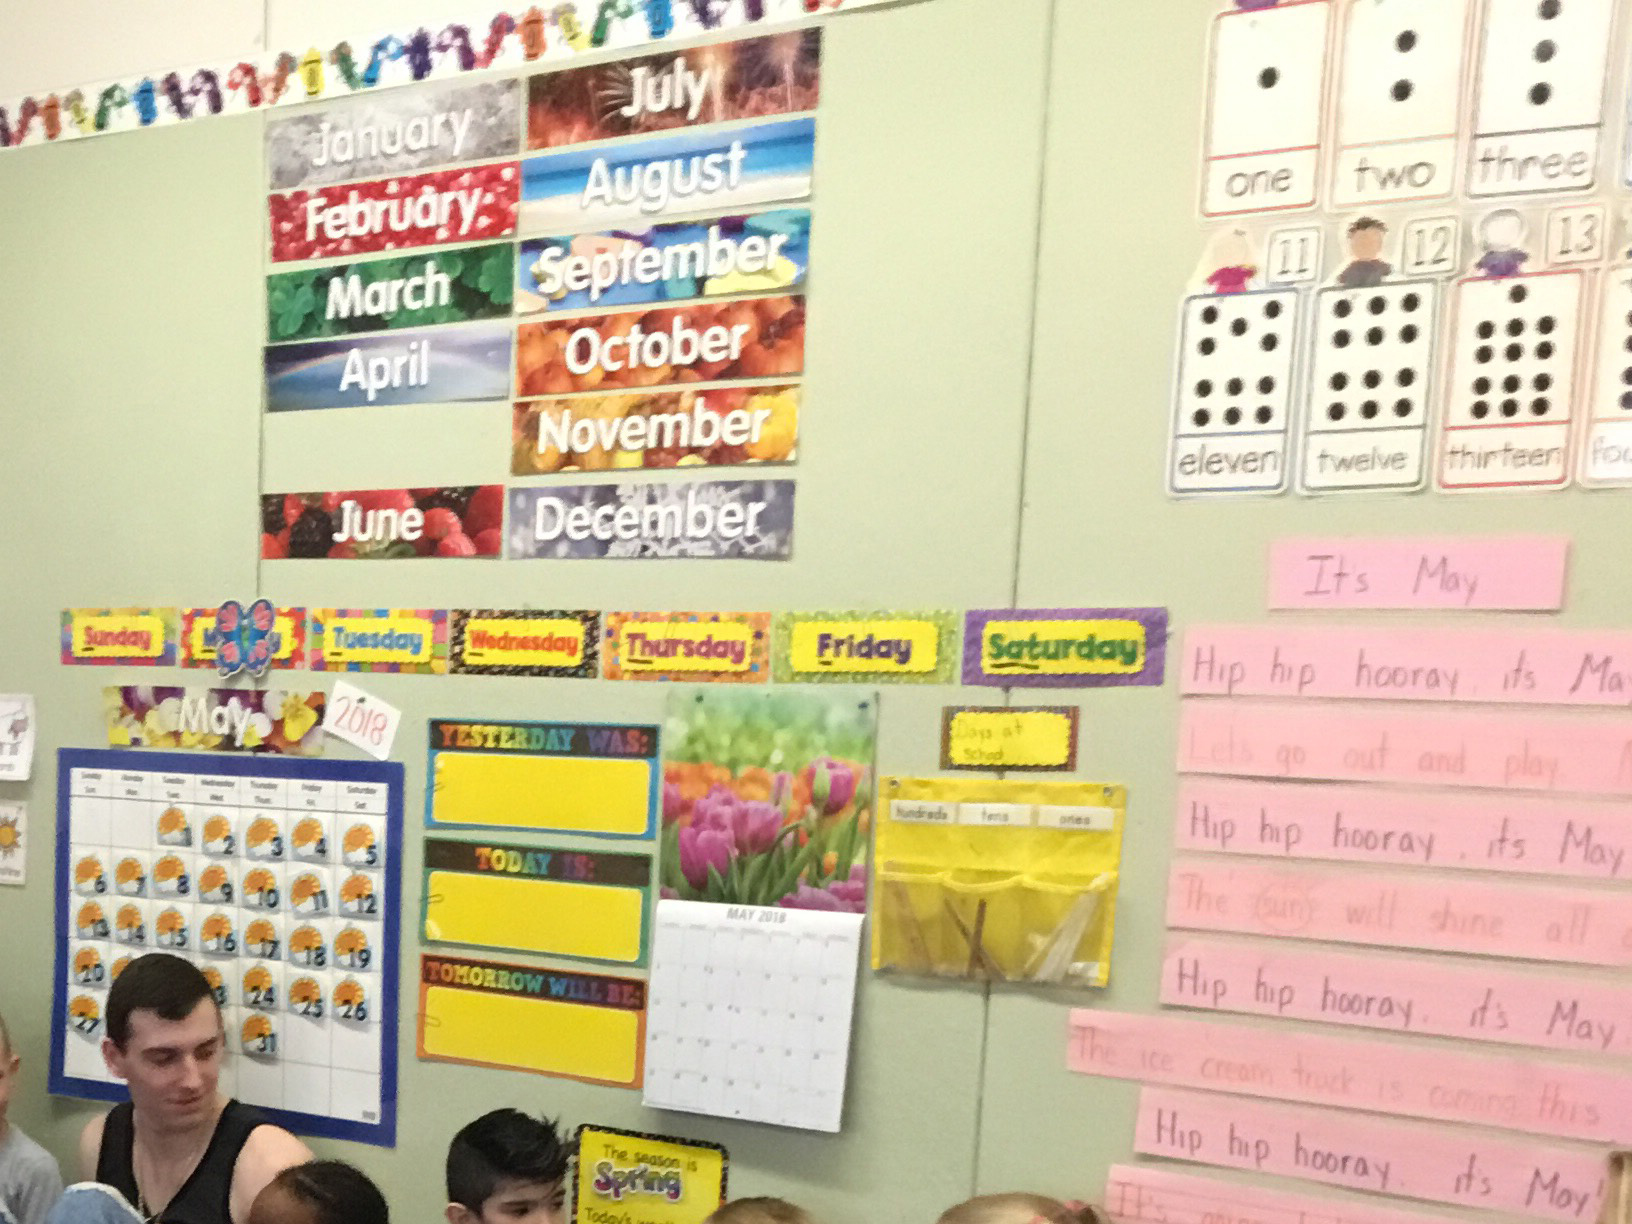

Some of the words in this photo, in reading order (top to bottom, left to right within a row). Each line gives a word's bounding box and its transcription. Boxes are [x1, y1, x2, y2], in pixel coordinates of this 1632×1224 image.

[621, 56, 711, 119] July
[312, 107, 473, 168] January
[581, 141, 747, 212] August
[1225, 166, 1293, 199] one
[1353, 156, 1436, 189] two
[1477, 144, 1590, 183] three
[304, 187, 482, 242] February
[1557, 213, 1597, 257] 13
[538, 226, 790, 300] September
[1276, 236, 1308, 277] 11
[1413, 227, 1450, 267] 12
[324, 262, 451, 321] March
[565, 315, 750, 376] October
[339, 341, 430, 402] April
[537, 397, 772, 456] November
[1178, 443, 1280, 478] eleven
[1316, 448, 1409, 474] twelve
[1444, 442, 1563, 472] thirteen
[331, 498, 426, 544] June
[533, 490, 768, 542] December
[1411, 554, 1479, 607] May
[83, 623, 152, 651] Sunday
[333, 625, 424, 656] Tuesday
[469, 628, 579, 657] Wednesday
[625, 631, 747, 667] Thursday
[817, 632, 913, 664] Friday
[989, 631, 1138, 665] Saturday
[1192, 645, 1246, 697] Hip
[1269, 646, 1316, 697] hip
[179, 695, 253, 748] May
[334, 694, 389, 746] 2018
[439, 723, 576, 751] YESTERDAY
[586, 729, 649, 755] WAS:
[1276, 743, 1307, 775] go
[1343, 731, 1390, 769] out
[1418, 741, 1467, 776] and
[1190, 801, 1236, 842] Hip
[1259, 806, 1301, 849] hip
[1559, 820, 1626, 878] May
[475, 847, 553, 875] TODAY
[562, 854, 596, 878] IS:
[727, 907, 757, 921] MAY
[759, 909, 788, 924] 2018
[426, 960, 544, 994] TOMORROW
[549, 975, 603, 1001] WILL
[606, 983, 644, 1006] BE:
[1176, 957, 1227, 1002] Hip
[1255, 966, 1296, 1013] hip
[1071, 1025, 1118, 1067] The
[1139, 1040, 1174, 1074] ice
[1200, 1049, 1274, 1084] cream
[1378, 1074, 1404, 1102] is
[1537, 1081, 1602, 1128] this
[603, 1143, 629, 1161] The
[634, 1151, 680, 1169] season
[686, 1156, 698, 1172] is
[1155, 1108, 1203, 1156] Hip
[1228, 1122, 1269, 1166] hip
[594, 1160, 682, 1202] Spring
